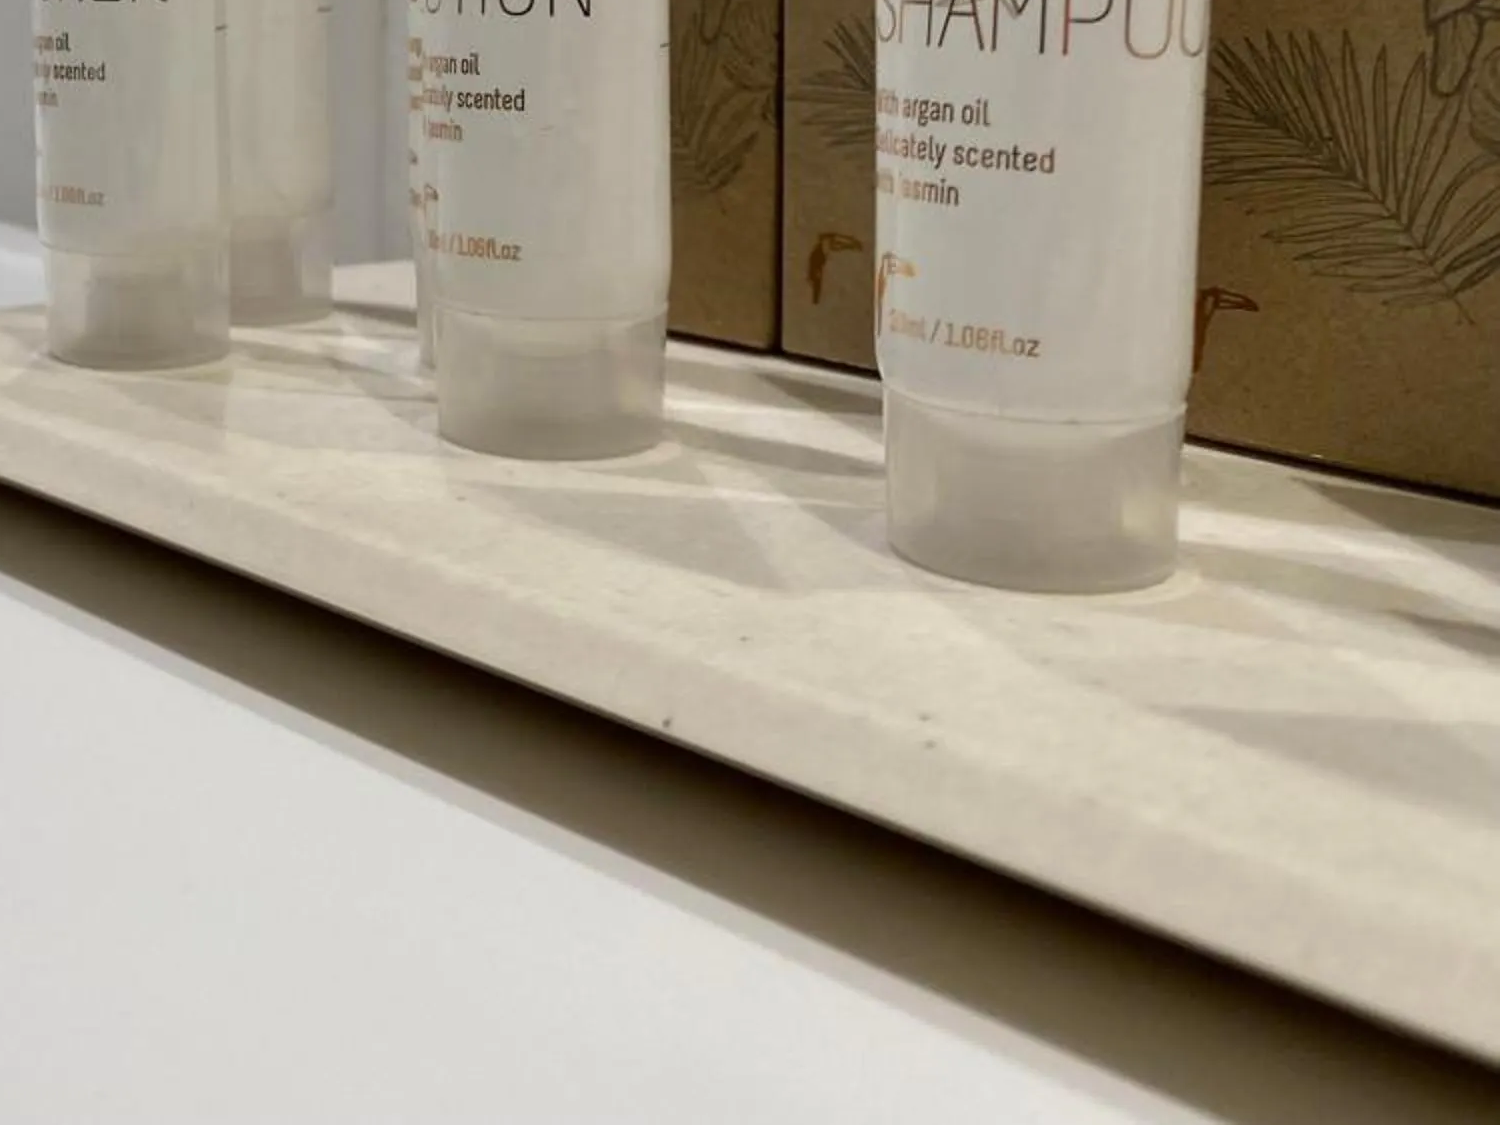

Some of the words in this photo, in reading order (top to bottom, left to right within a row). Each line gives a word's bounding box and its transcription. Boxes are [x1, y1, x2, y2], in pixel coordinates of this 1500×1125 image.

[460, 51, 481, 76] oil
[457, 87, 526, 113] scented
[902, 97, 955, 128] argan
[961, 95, 992, 128] oil
[953, 144, 1058, 175] scented
[899, 174, 960, 207] asmin
